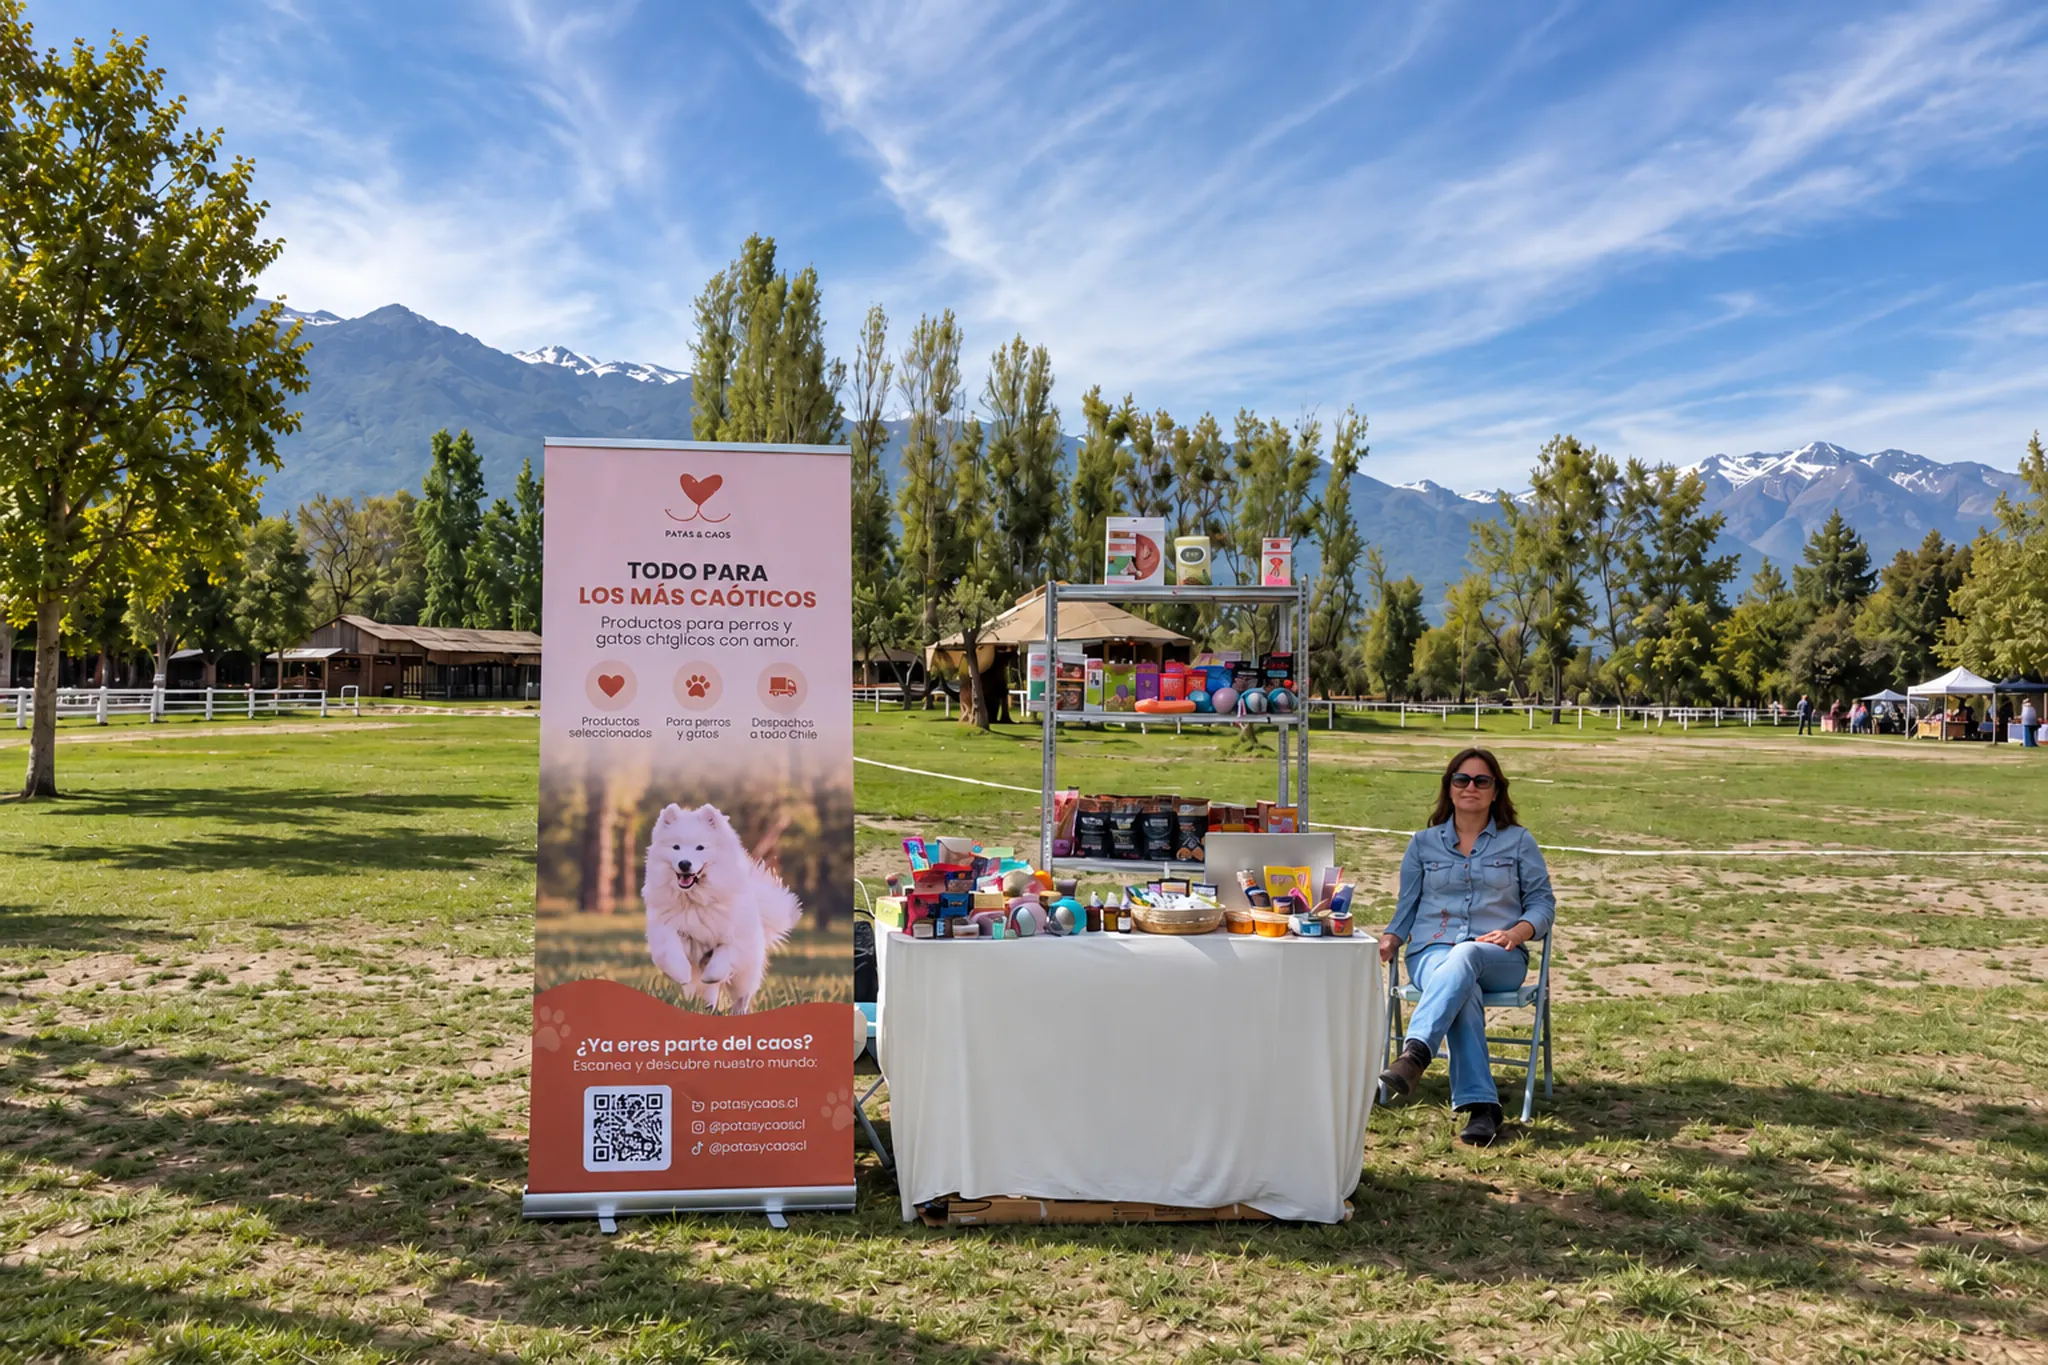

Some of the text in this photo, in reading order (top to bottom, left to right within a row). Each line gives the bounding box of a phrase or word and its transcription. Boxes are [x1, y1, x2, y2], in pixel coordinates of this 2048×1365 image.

[665, 530, 694, 538] PATAS
[704, 530, 731, 539] CAOS
[627, 562, 768, 582] TODO PARA
[579, 583, 817, 608] LOS MÁS CAÓTICOS
[601, 616, 792, 634] Productos para perros y
[596, 633, 641, 648] gatos
[720, 637, 749, 647] con
[753, 637, 799, 648] amor.
[582, 716, 640, 726] Productos
[666, 716, 731, 729] Para perros
[752, 717, 814, 730] Despachos
[569, 728, 652, 738] seleccionados
[677, 730, 719, 741] y gatos
[750, 730, 818, 740] a todo Chile
[576, 1034, 813, 1056] ¿Ya eres parte del caos?
[573, 1060, 632, 1071] Escanea
[635, 1062, 644, 1073] y
[646, 1058, 710, 1070] descubre
[713, 1057, 764, 1069] nuestro
